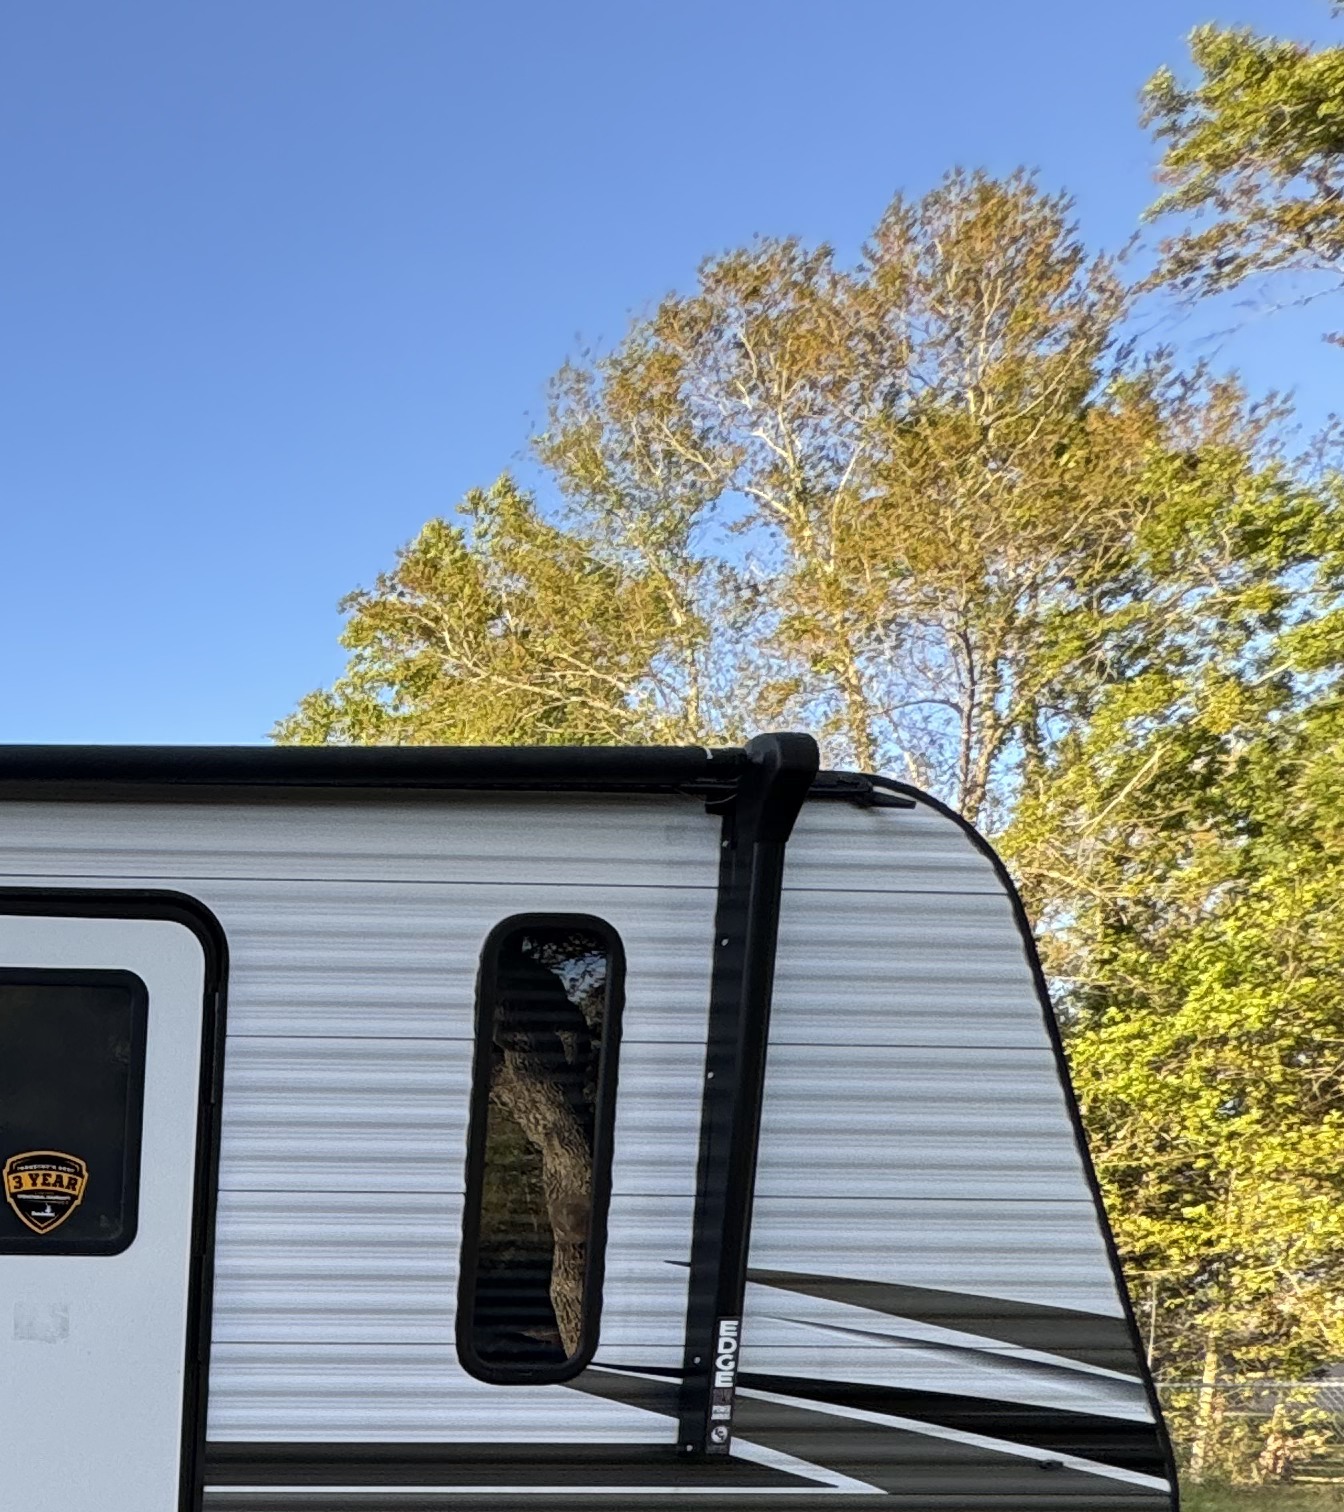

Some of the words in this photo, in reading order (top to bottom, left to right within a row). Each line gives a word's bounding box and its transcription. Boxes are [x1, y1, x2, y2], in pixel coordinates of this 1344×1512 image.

[12, 1175, 23, 1190] 3
[28, 1172, 78, 1191] YEAR
[714, 1320, 739, 1388] EDGE
